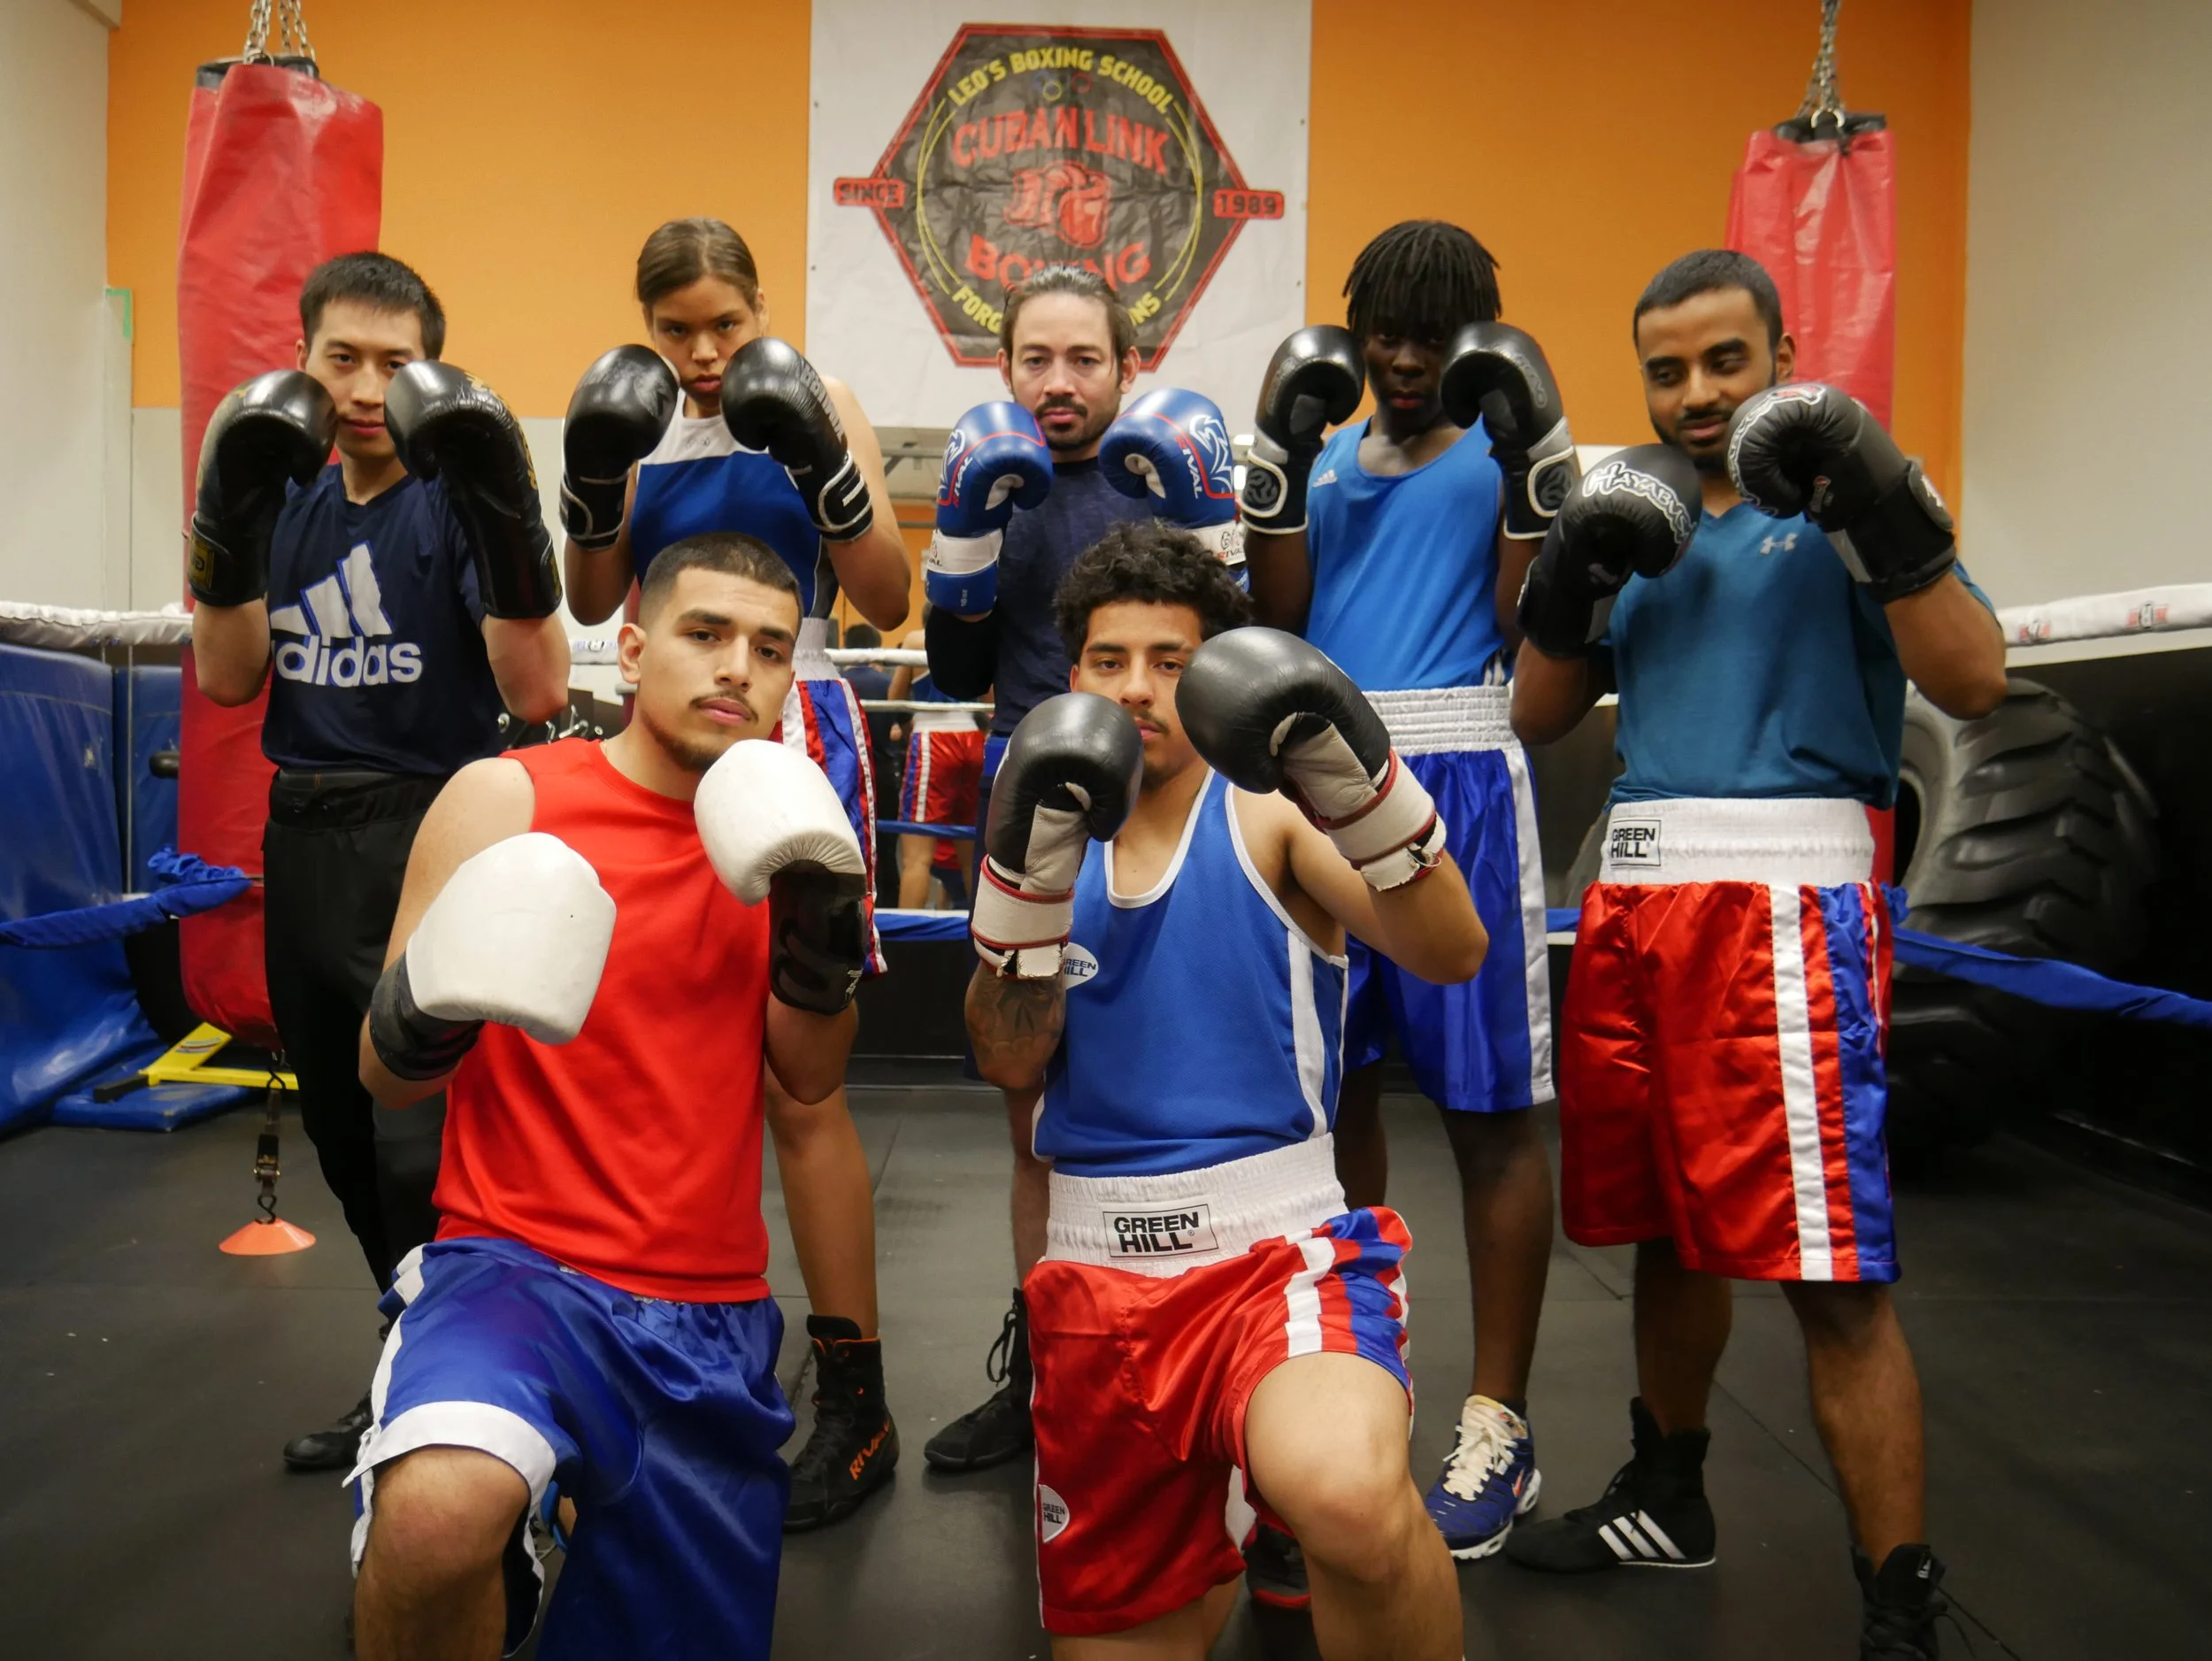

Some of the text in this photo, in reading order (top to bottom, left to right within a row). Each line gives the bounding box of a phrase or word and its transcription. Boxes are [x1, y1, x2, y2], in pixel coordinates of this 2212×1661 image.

[948, 47, 1175, 115] LEO'S BOXING SCHOOL
[952, 105, 1170, 176] CUBAN LINK
[840, 182, 899, 202] SINCE
[1220, 195, 1277, 215] 1989
[965, 233, 1151, 295] BONG
[1175, 434, 1203, 500] RIVAL
[272, 633, 423, 688] didas
[1612, 827, 1655, 842] GREEN
[1610, 842, 1647, 858] HILL
[1065, 958, 1097, 971] REEN
[1113, 1211, 1200, 1234] GREEN
[1118, 1232, 1194, 1253] HILL
